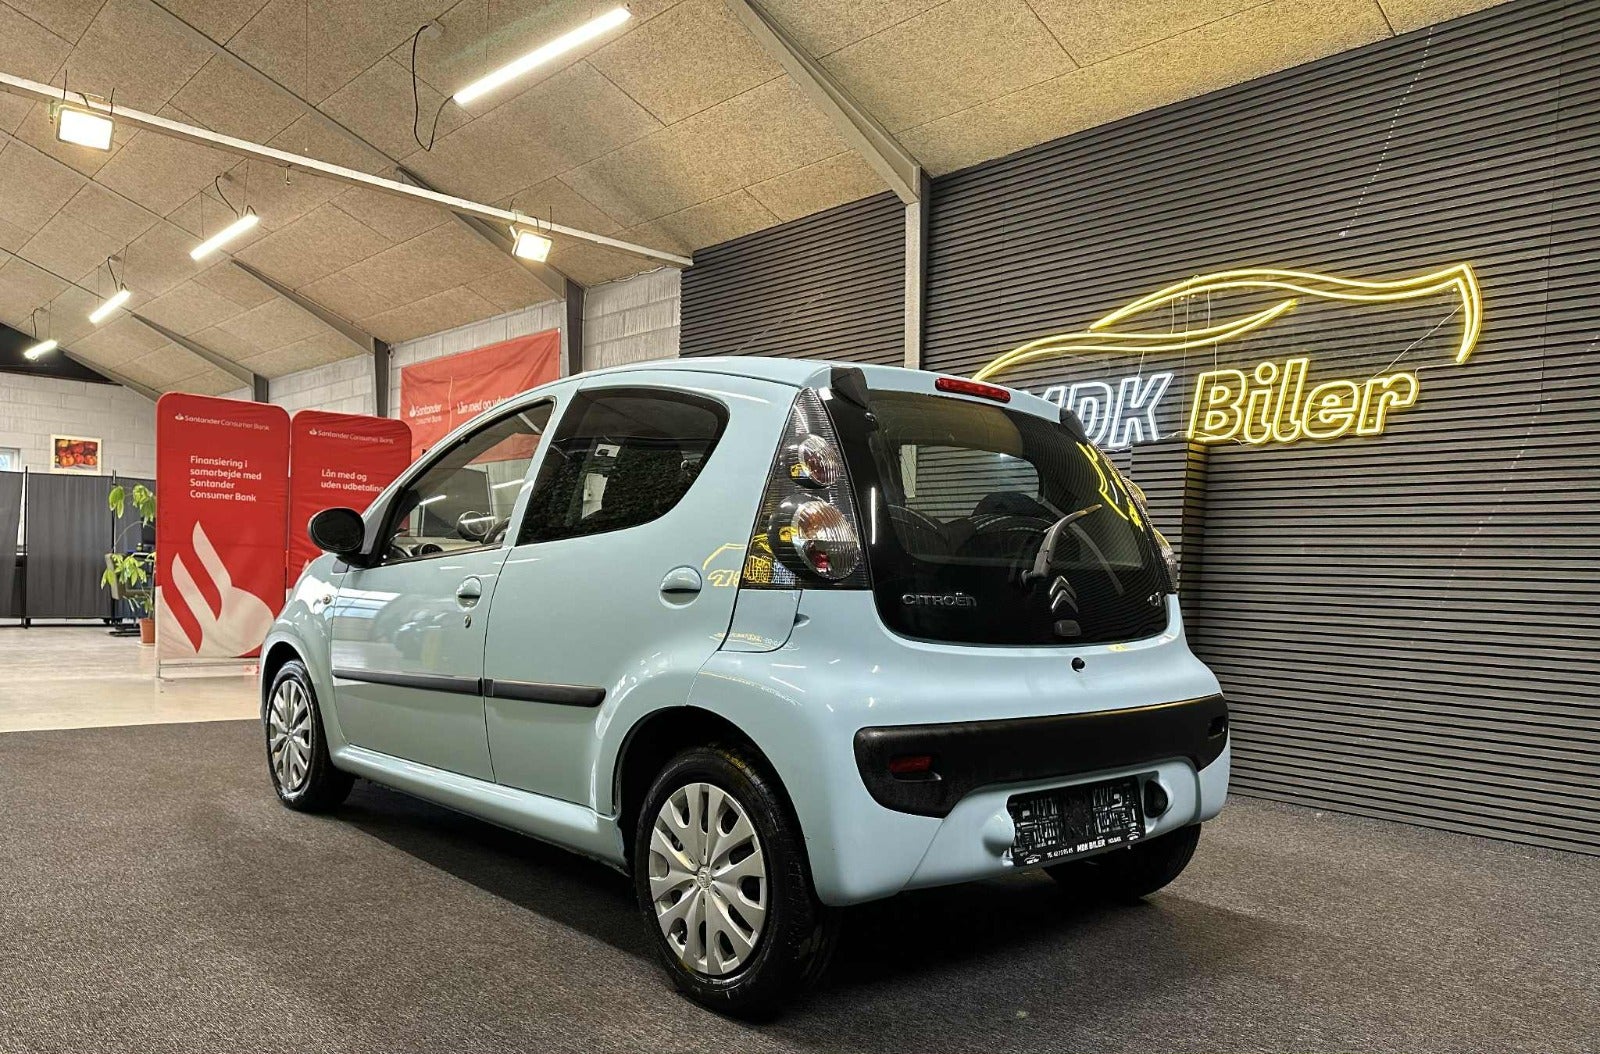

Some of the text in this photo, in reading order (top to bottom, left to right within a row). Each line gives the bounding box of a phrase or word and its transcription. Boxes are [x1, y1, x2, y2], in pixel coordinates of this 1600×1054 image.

[1187, 357, 1421, 445] Biler
[415, 404, 442, 417] Santander
[184, 415, 270, 431] Santander Consumer Bank
[317, 430, 394, 444] Santander Consumer Bank
[190, 455, 248, 469] Finansiering i
[190, 468, 262, 480] samarbejde med
[321, 468, 367, 483] Lån med og
[190, 478, 235, 489] Santander
[320, 480, 341, 489] uden
[190, 489, 257, 502] Consumer Bank
